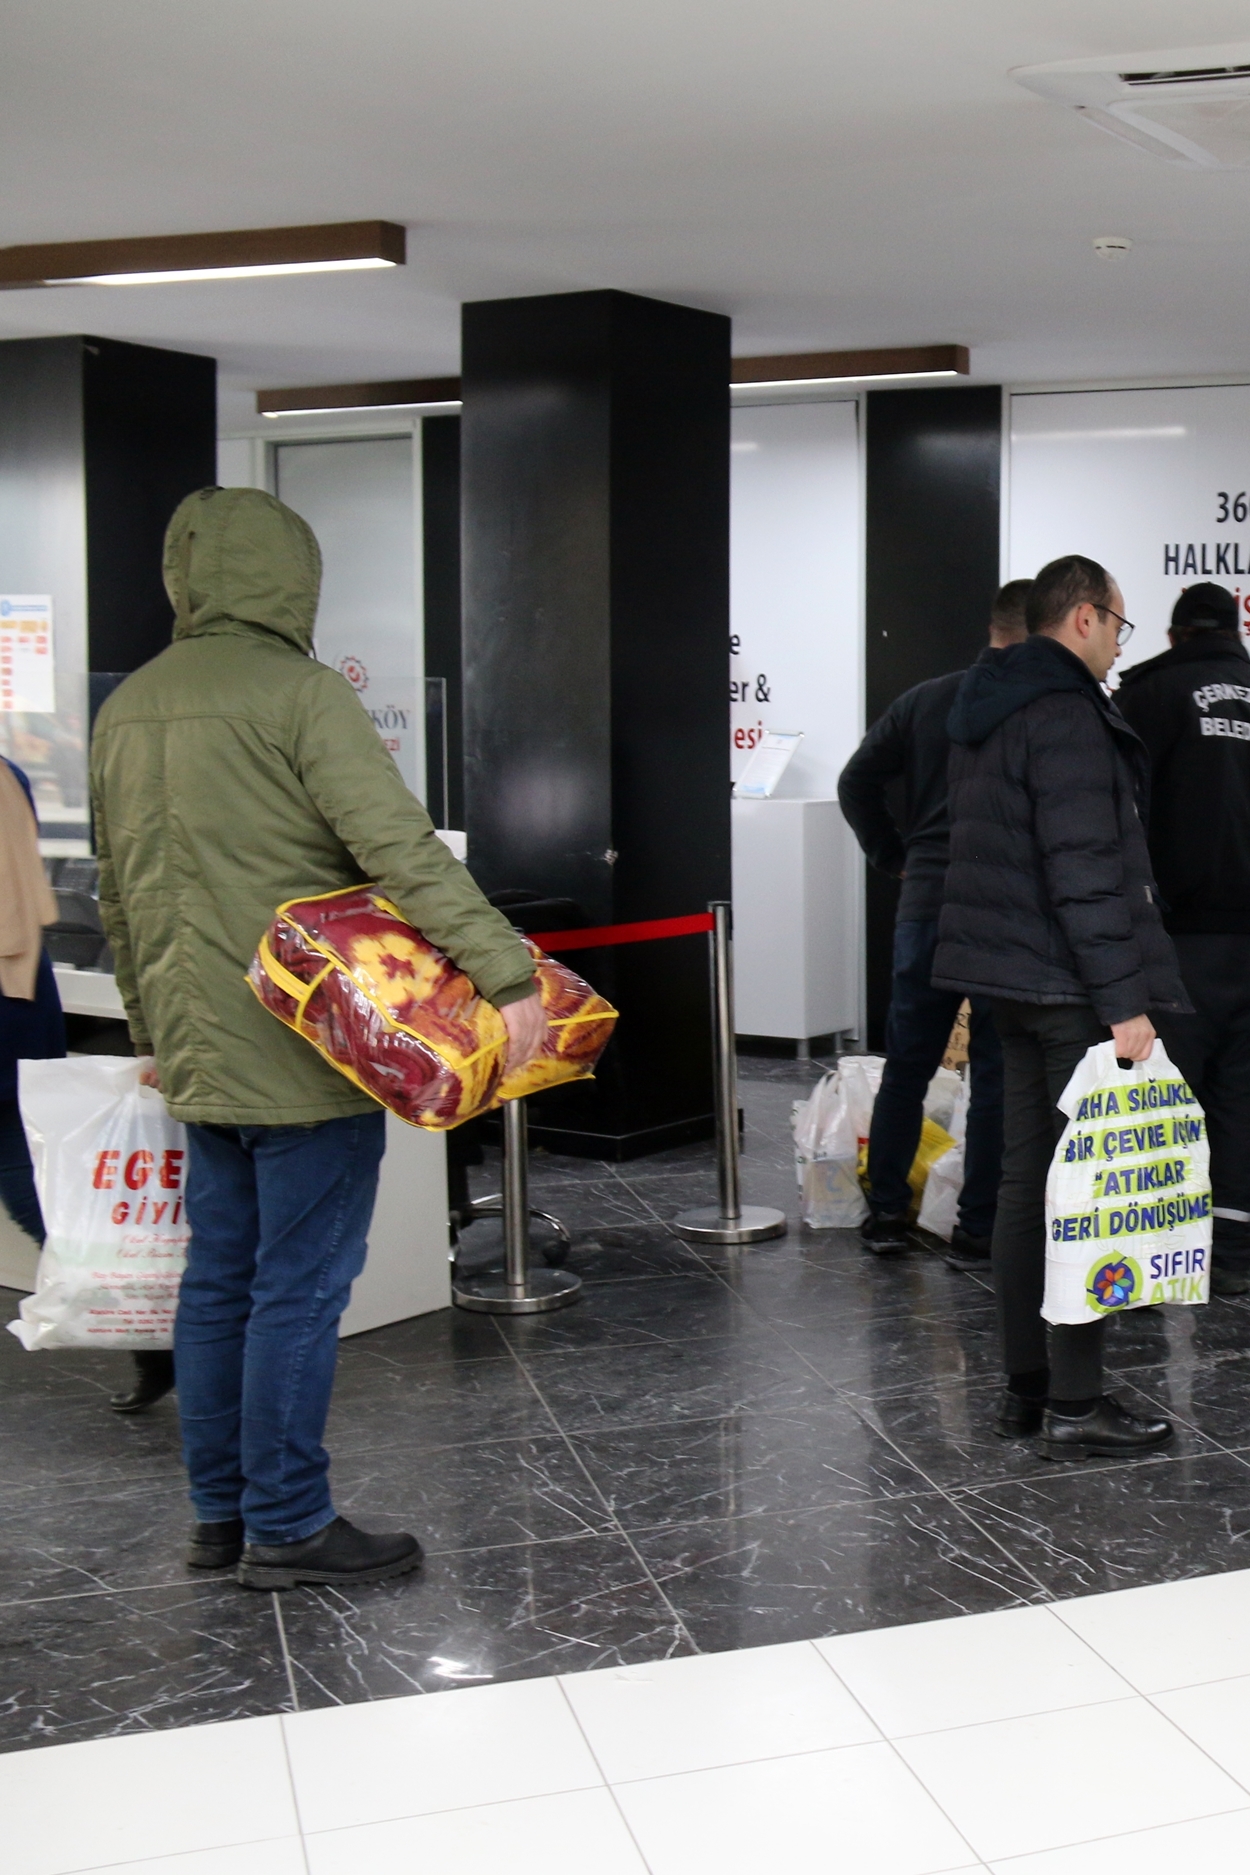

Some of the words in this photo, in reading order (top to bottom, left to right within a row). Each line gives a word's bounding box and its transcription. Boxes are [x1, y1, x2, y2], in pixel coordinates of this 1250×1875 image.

[755, 673, 771, 703] &
[369, 704, 410, 730] KÖY
[734, 720, 762, 749] esi
[1076, 1091, 1120, 1121] AHA
[1128, 1077, 1197, 1112] SAĞLIKL
[1065, 1130, 1095, 1162] BİR
[1103, 1123, 1166, 1162] ÇEVRE
[1173, 1114, 1202, 1149] İÇİN
[92, 1149, 185, 1190] EGE
[111, 1195, 190, 1225] GİYİ
[1150, 1248, 1205, 1279] SIFIR
[1151, 1274, 1204, 1304] ATIK
